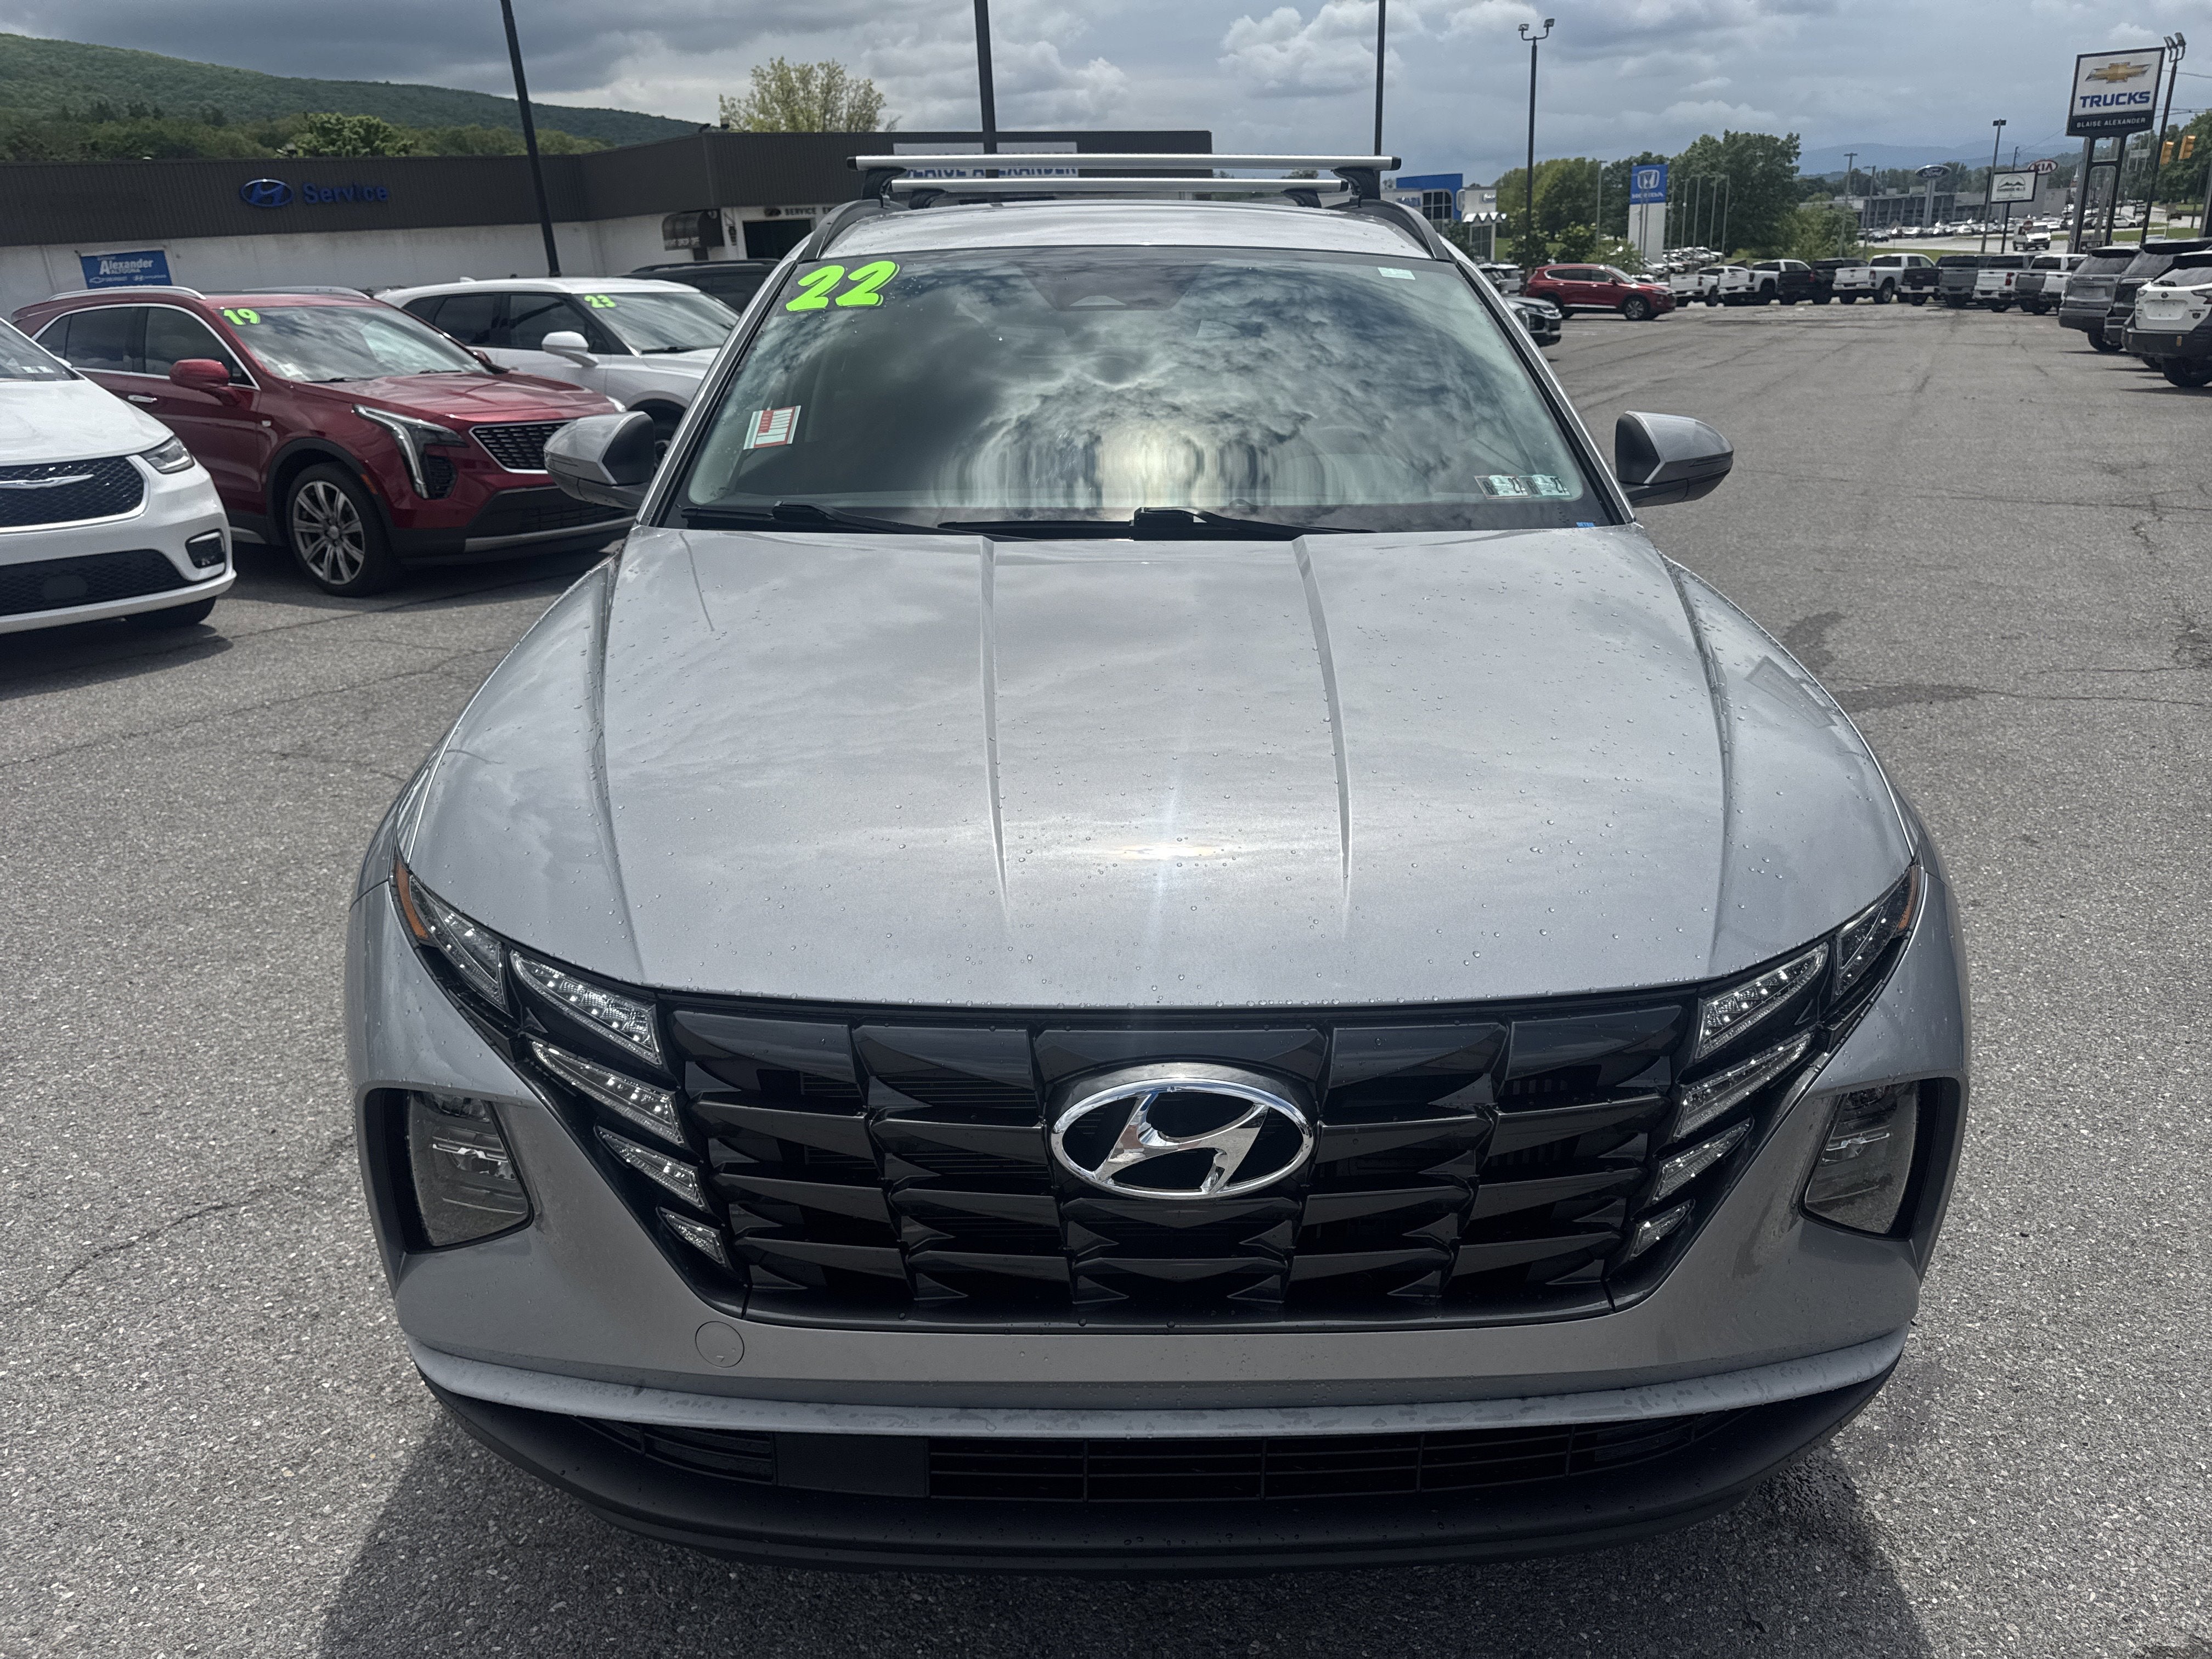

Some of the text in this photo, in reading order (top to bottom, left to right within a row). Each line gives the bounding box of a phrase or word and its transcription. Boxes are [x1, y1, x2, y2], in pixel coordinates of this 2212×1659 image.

[2079, 91, 2151, 108] TRUCKS
[2076, 117, 2146, 128] BLAISE ALEXANDER
[302, 182, 388, 204] Service
[99, 258, 154, 275] Alexander
[786, 261, 900, 312] 22
[584, 295, 617, 308] 23
[223, 308, 261, 325] 19
